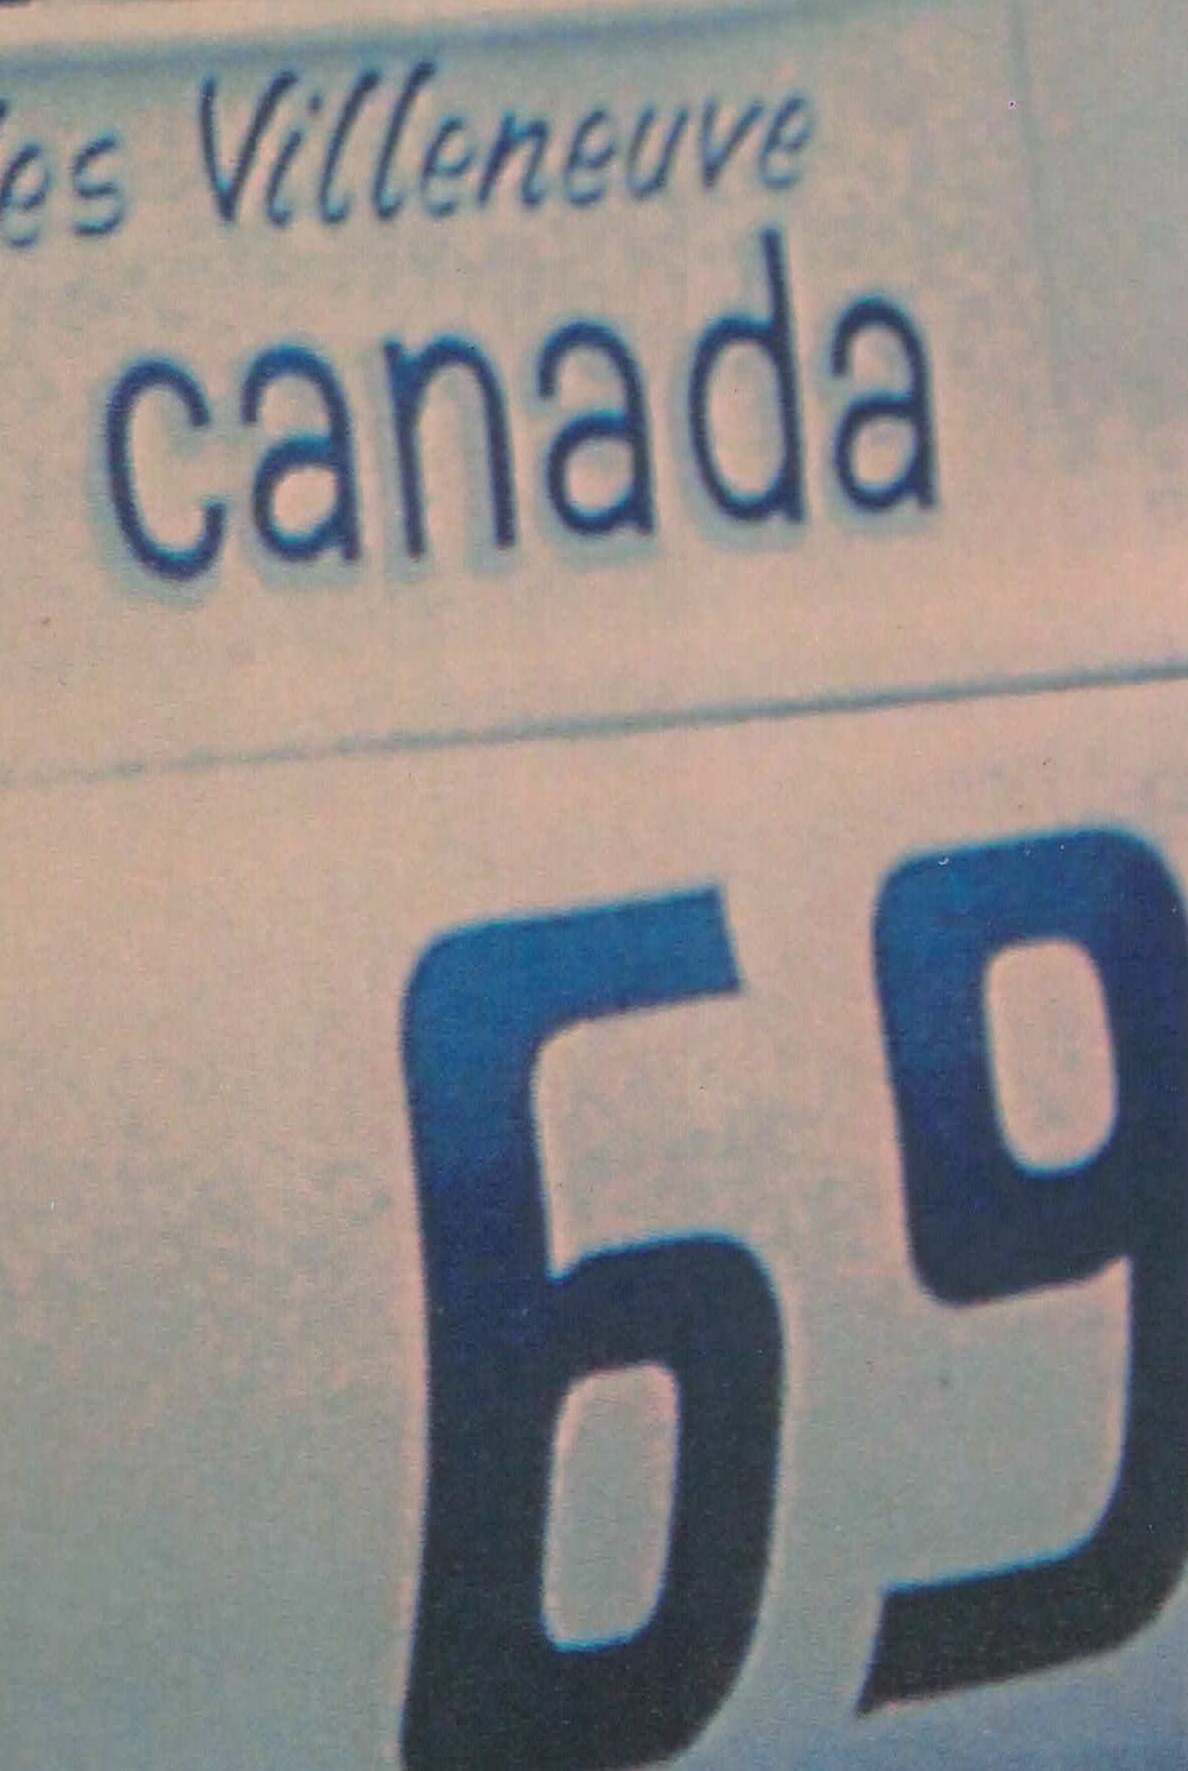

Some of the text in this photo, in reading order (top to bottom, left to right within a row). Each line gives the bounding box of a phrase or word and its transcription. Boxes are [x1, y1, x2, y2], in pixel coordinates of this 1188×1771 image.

[197, 61, 814, 229] Villeneuve
[104, 229, 938, 581] canada
[400, 825, 1188, 1771] 69
